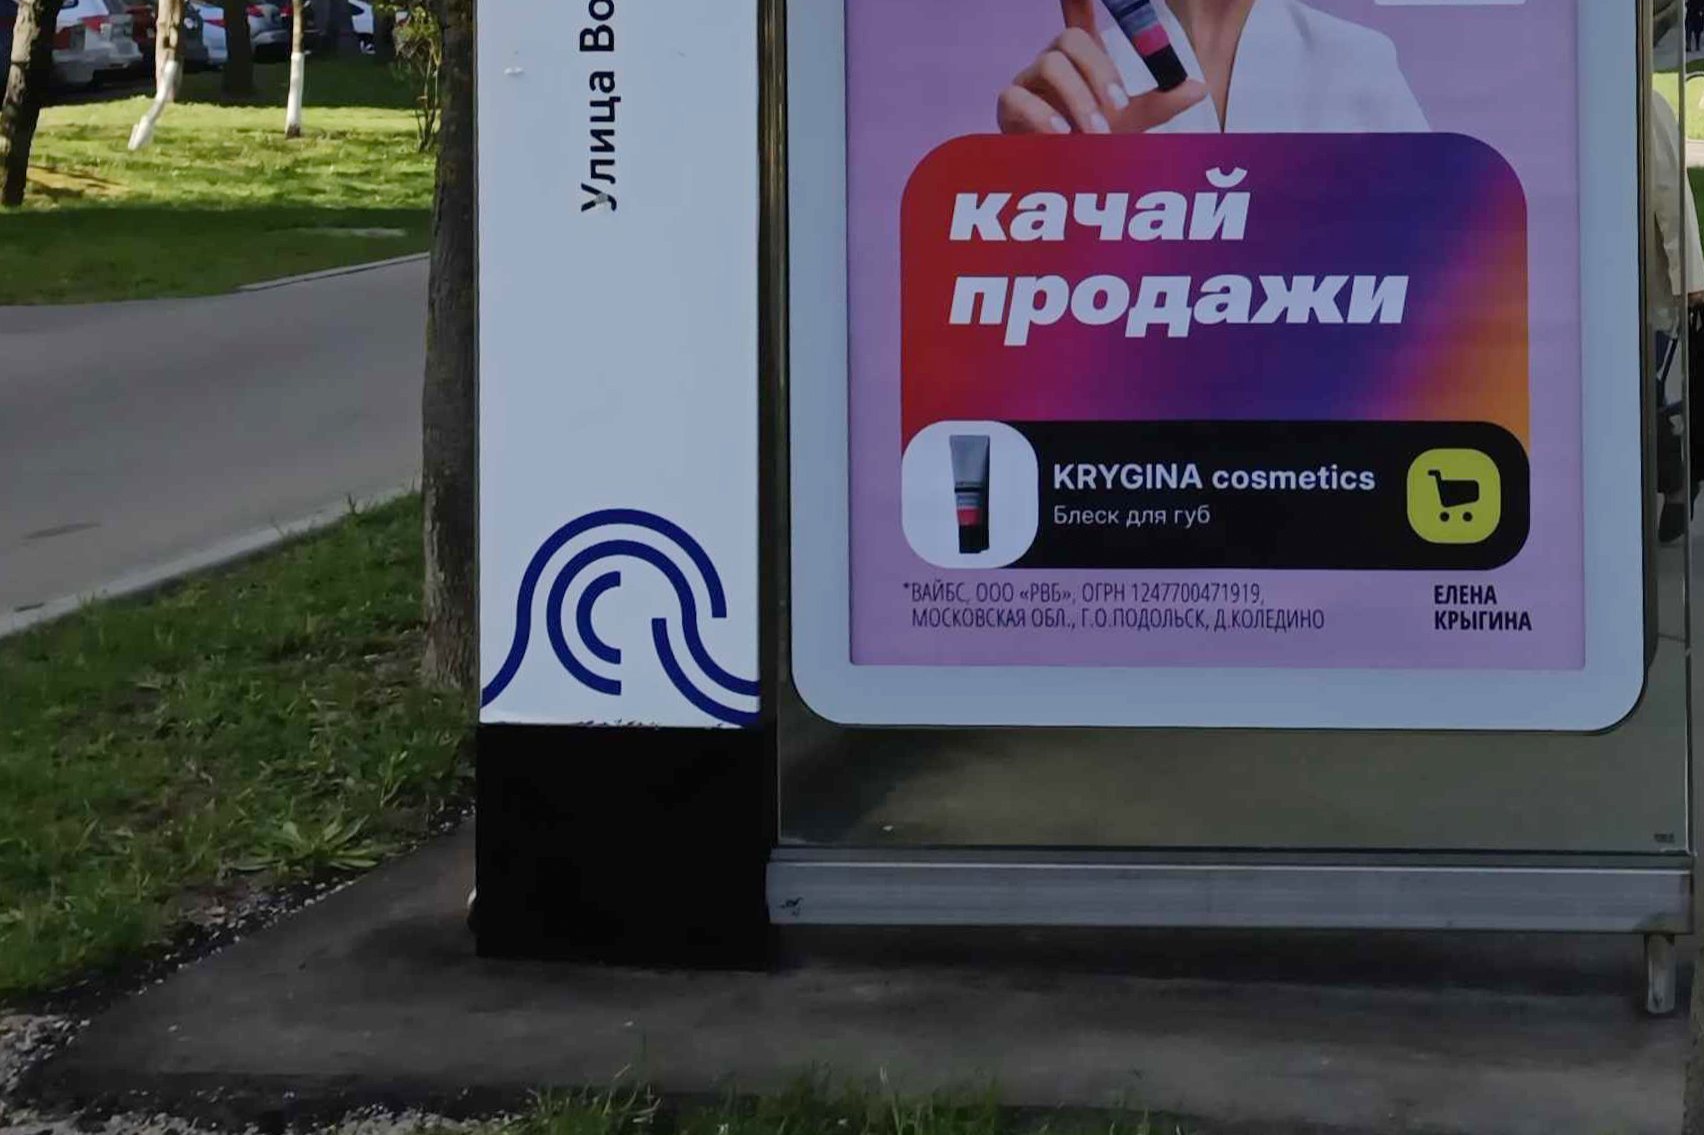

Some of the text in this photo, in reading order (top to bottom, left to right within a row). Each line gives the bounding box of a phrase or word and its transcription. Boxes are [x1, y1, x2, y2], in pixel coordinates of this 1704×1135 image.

[581, 71, 620, 212] Улица
[950, 167, 1250, 241] качай
[949, 275, 1409, 346] продажи
[1054, 463, 1375, 490] KRYGINA cosmetics
[1054, 505, 1210, 529] Блеск для губ
[976, 582, 1013, 602] ООО
[1082, 583, 1124, 602] ОГРН
[1435, 585, 1497, 604] ЕЛЕНА
[913, 608, 1025, 627] МОСКОВСКАЯ
[1435, 611, 1532, 630] КРЫГИНА
